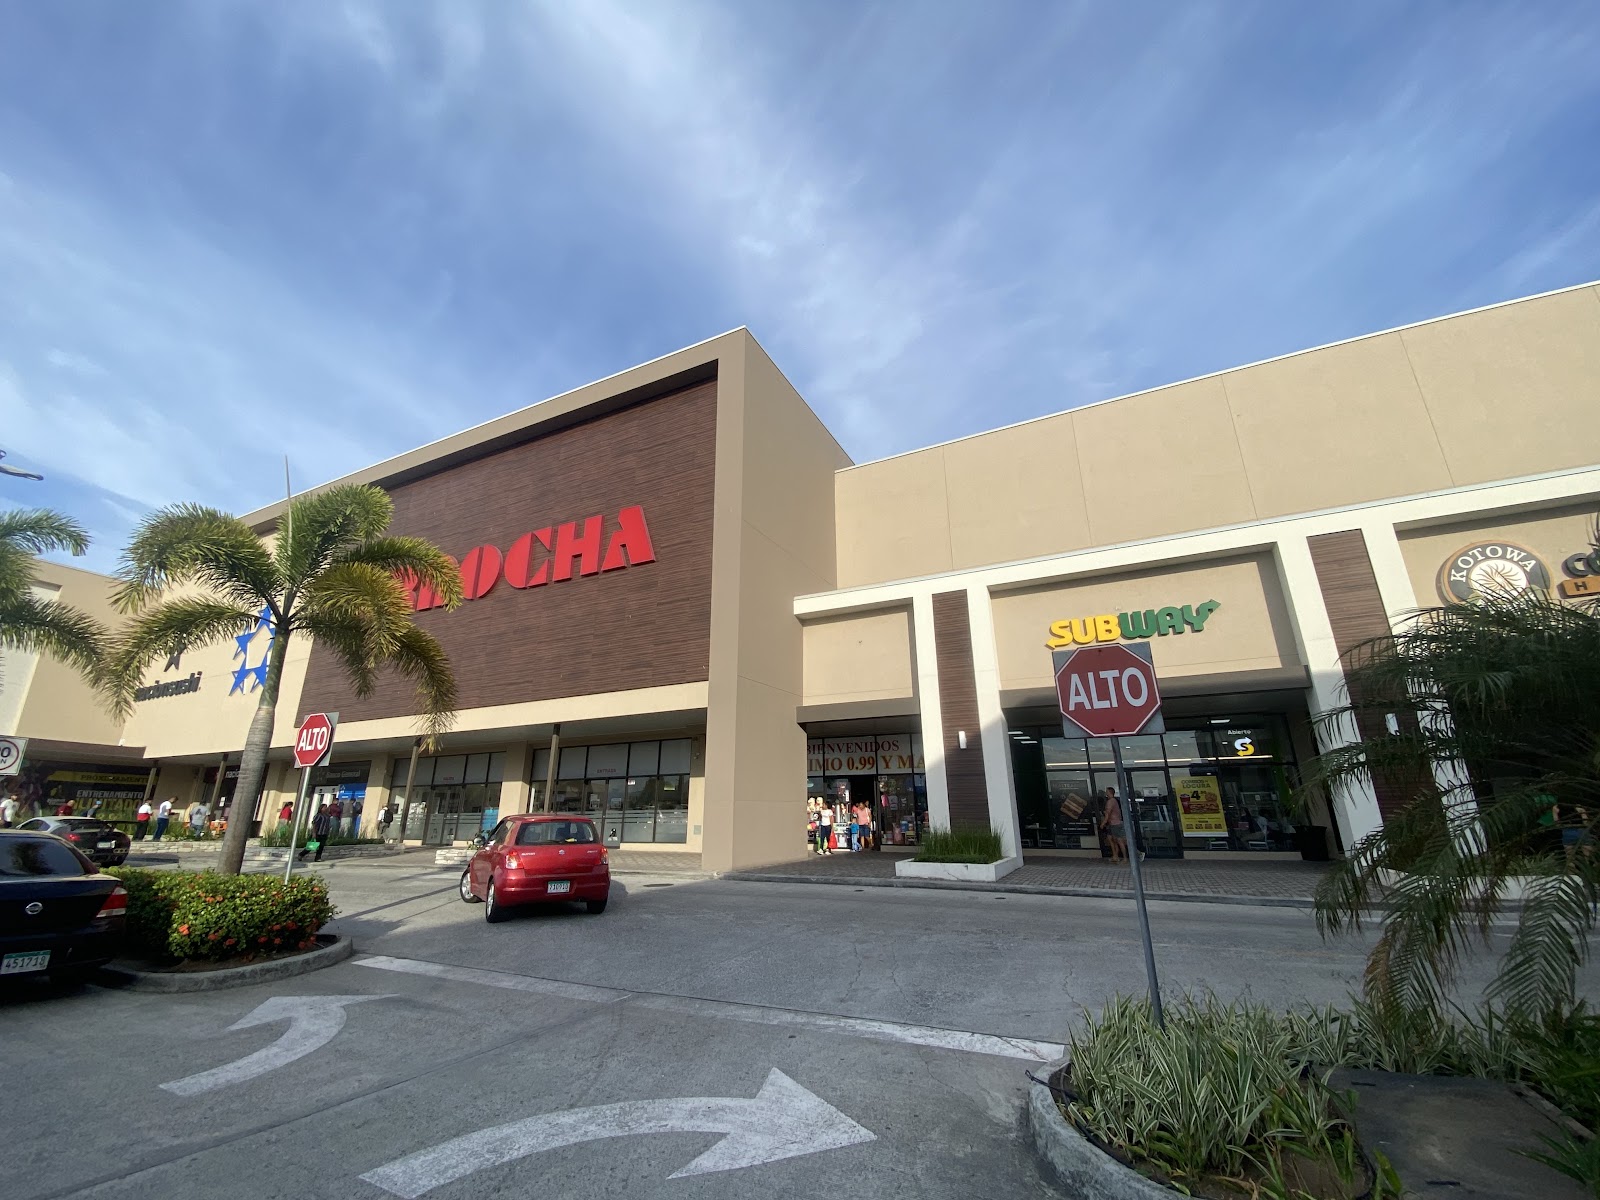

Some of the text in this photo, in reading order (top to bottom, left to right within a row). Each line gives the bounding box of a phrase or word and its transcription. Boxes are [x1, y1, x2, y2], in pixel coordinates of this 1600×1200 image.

[1451, 546, 1537, 583] KOTOWA
[1046, 599, 1221, 649] SUBWAY
[1068, 667, 1148, 711] ALTO
[297, 726, 327, 751] ALTO
[807, 740, 900, 755] BIENVENIDOS
[807, 754, 925, 772] IMO 0.99 Y MA
[76, 789, 144, 799] ENTRENAMIENTO
[5, 955, 46, 969] 451718
